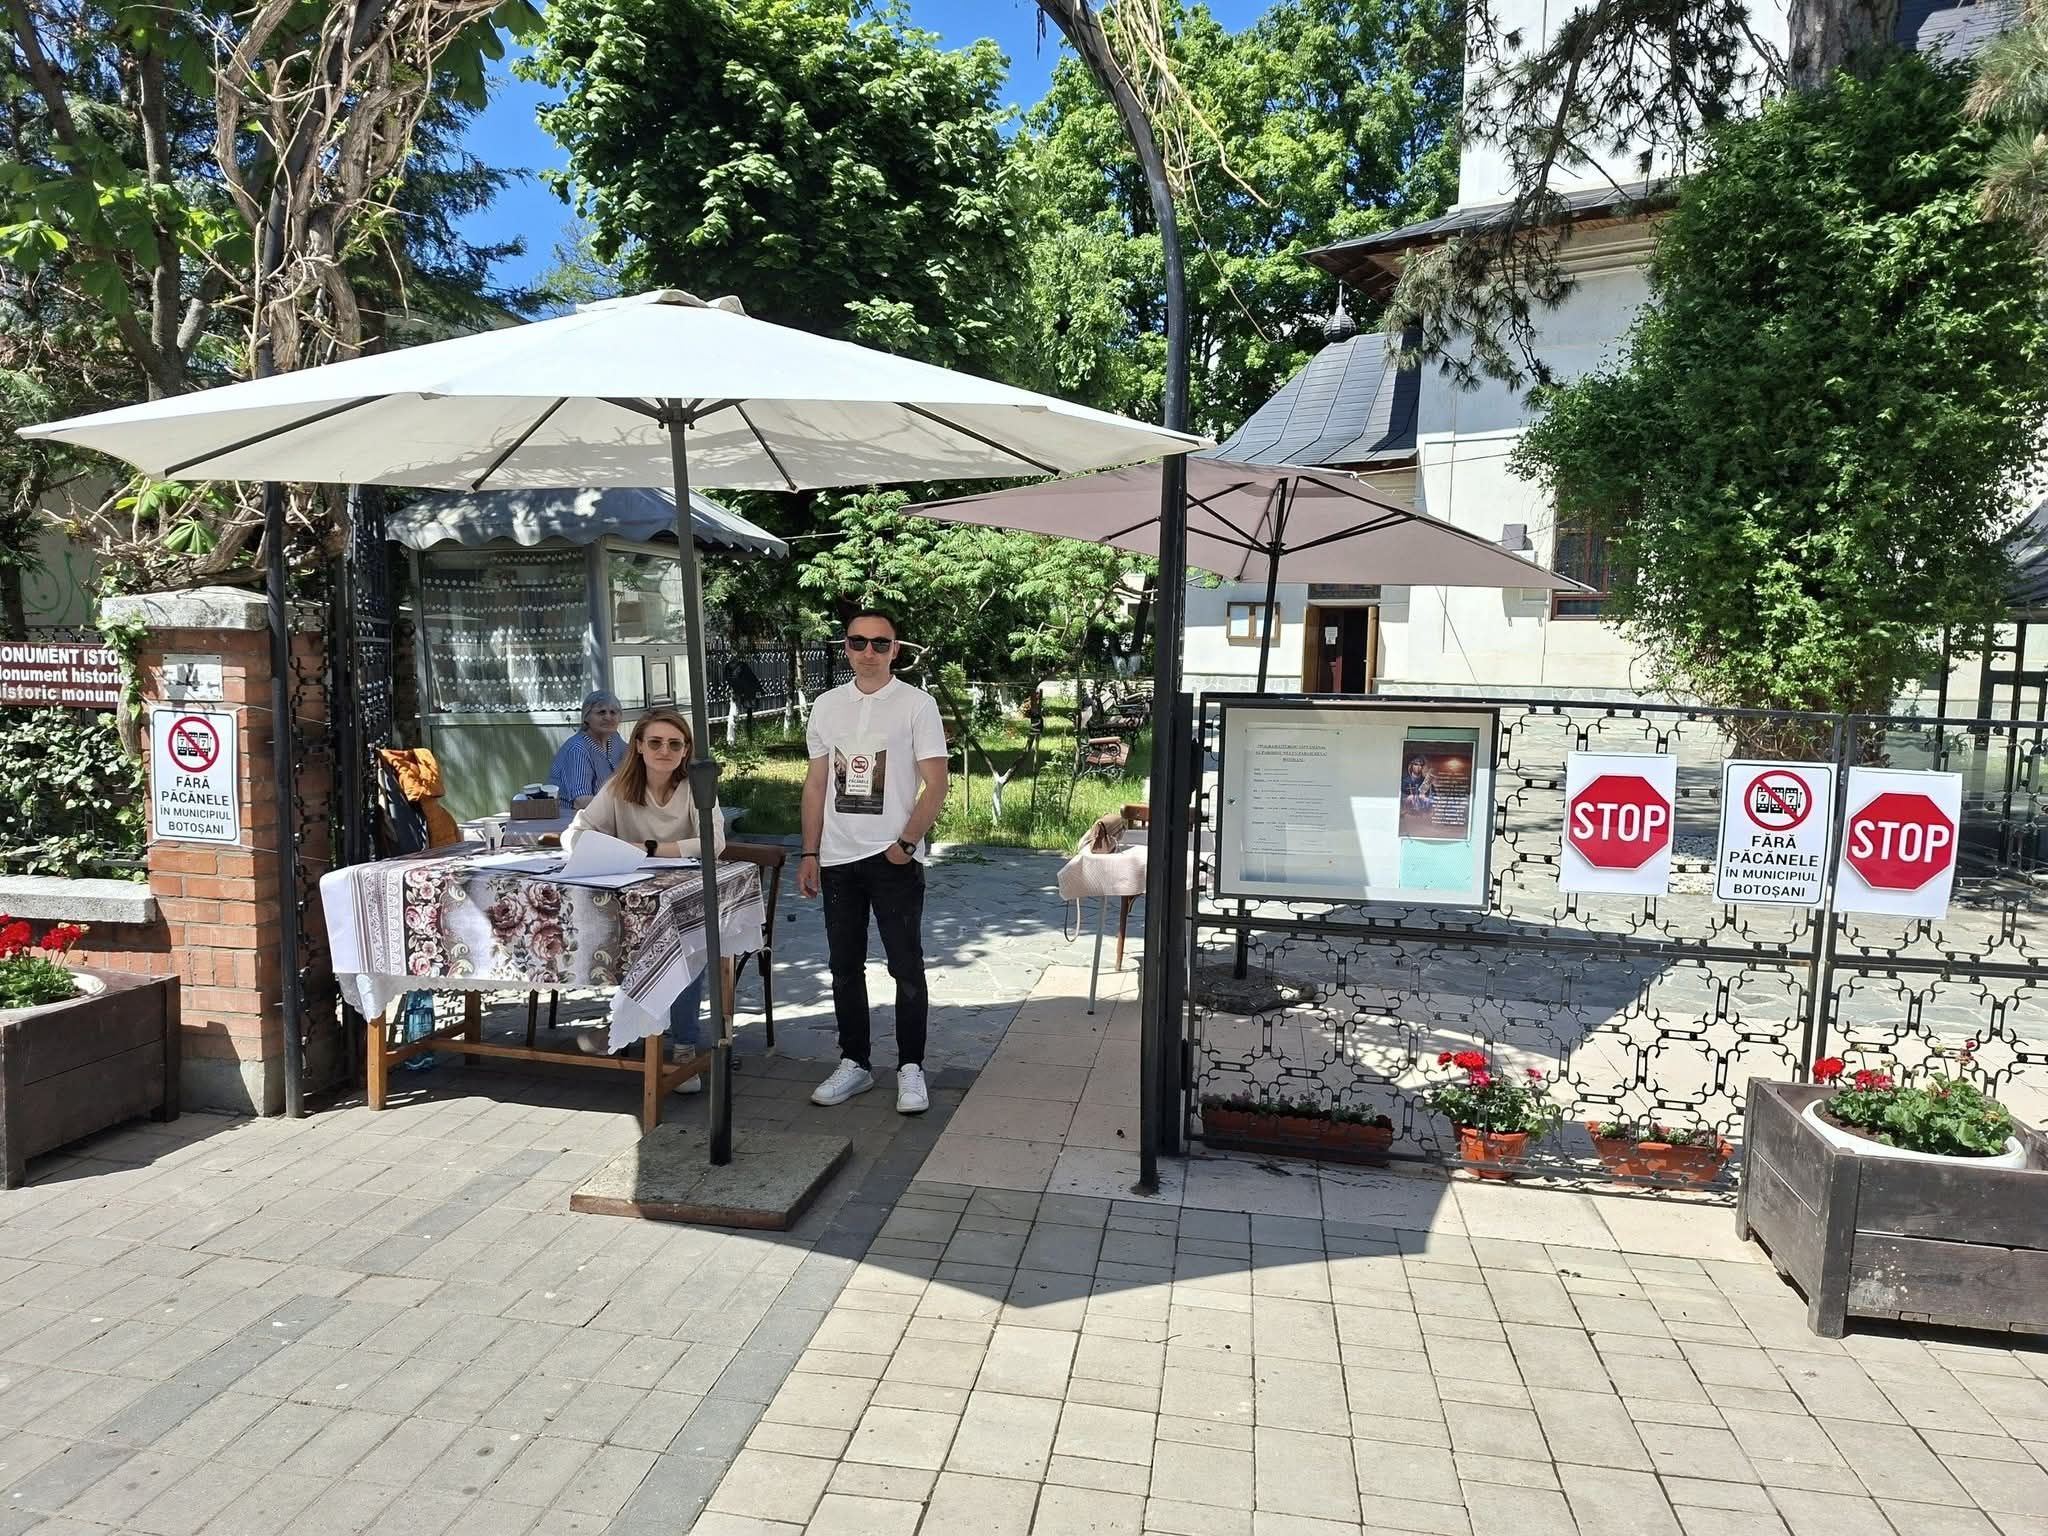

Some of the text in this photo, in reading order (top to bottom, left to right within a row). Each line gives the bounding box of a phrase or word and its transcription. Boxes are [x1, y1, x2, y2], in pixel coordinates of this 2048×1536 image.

[0, 646, 120, 666] ONUMENT ISTO
[0, 665, 68, 683] onument
[0, 682, 119, 702] istoric monum
[176, 774, 210, 789] FĂRĂ
[161, 789, 229, 807] PĂCĂNELE
[173, 807, 231, 821] MUNICIPIUL
[1573, 801, 1666, 843] STOP
[1752, 833, 1796, 849] FĂRĂ
[1851, 819, 1950, 863] STOP
[1729, 848, 1819, 868] PĂCĂNELE
[1725, 866, 1818, 882] ÎN MUNICIPIUL
[1733, 883, 1805, 899] BOTOȘANI
